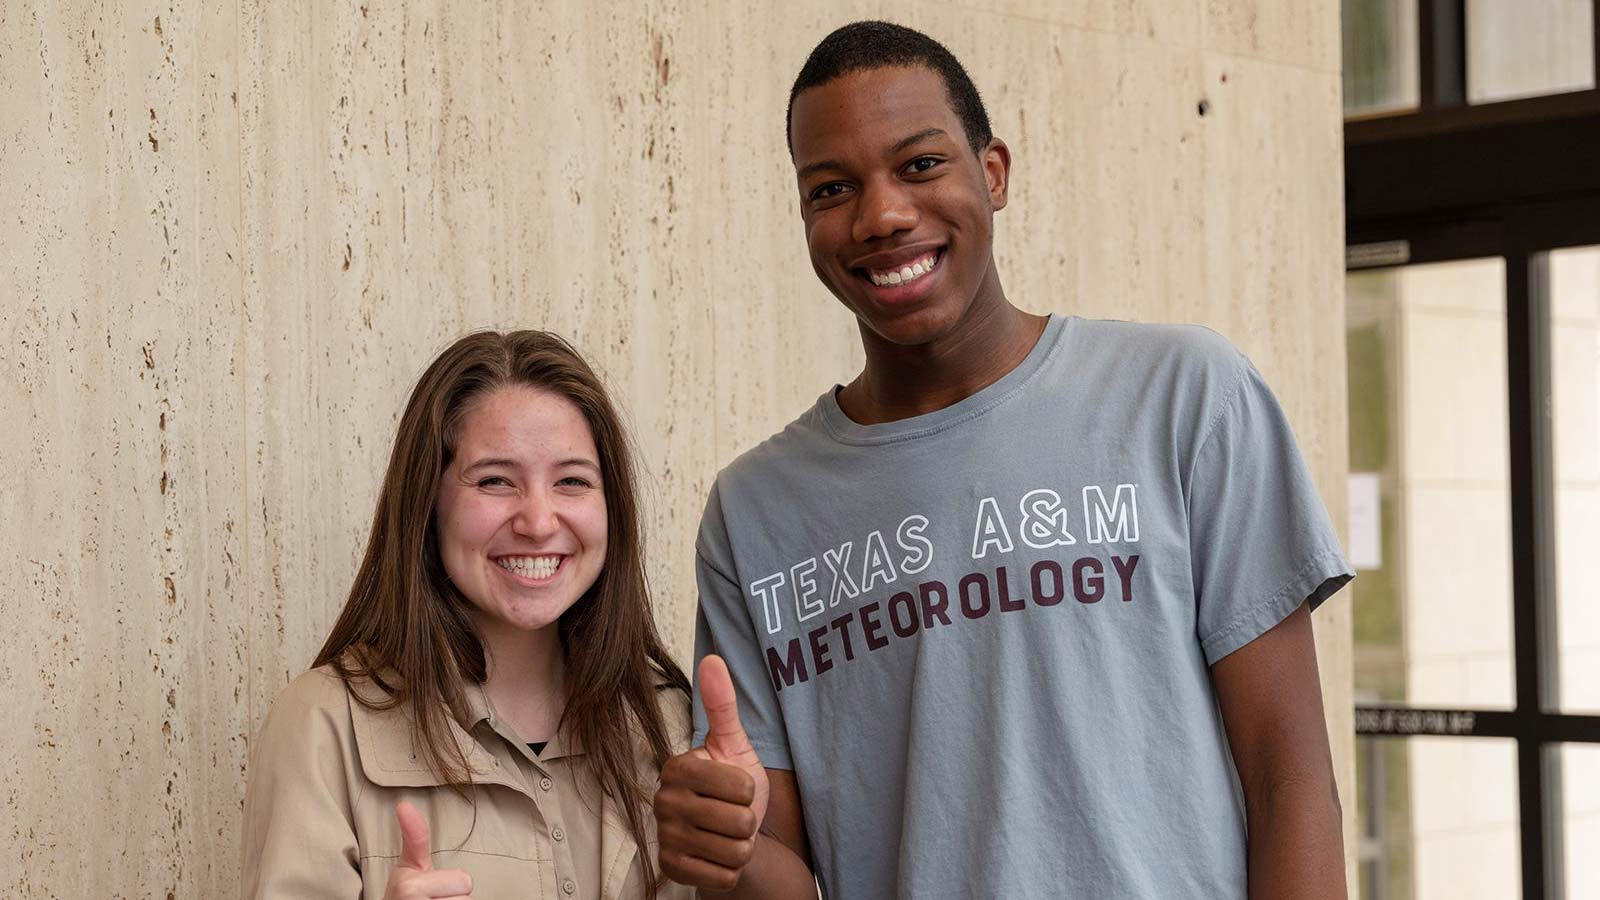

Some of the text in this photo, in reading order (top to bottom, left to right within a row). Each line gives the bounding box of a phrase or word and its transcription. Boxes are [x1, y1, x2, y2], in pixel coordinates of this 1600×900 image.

[751, 484, 1140, 634] TEXAS A&M
[766, 555, 1141, 692] METEOROLOGY
